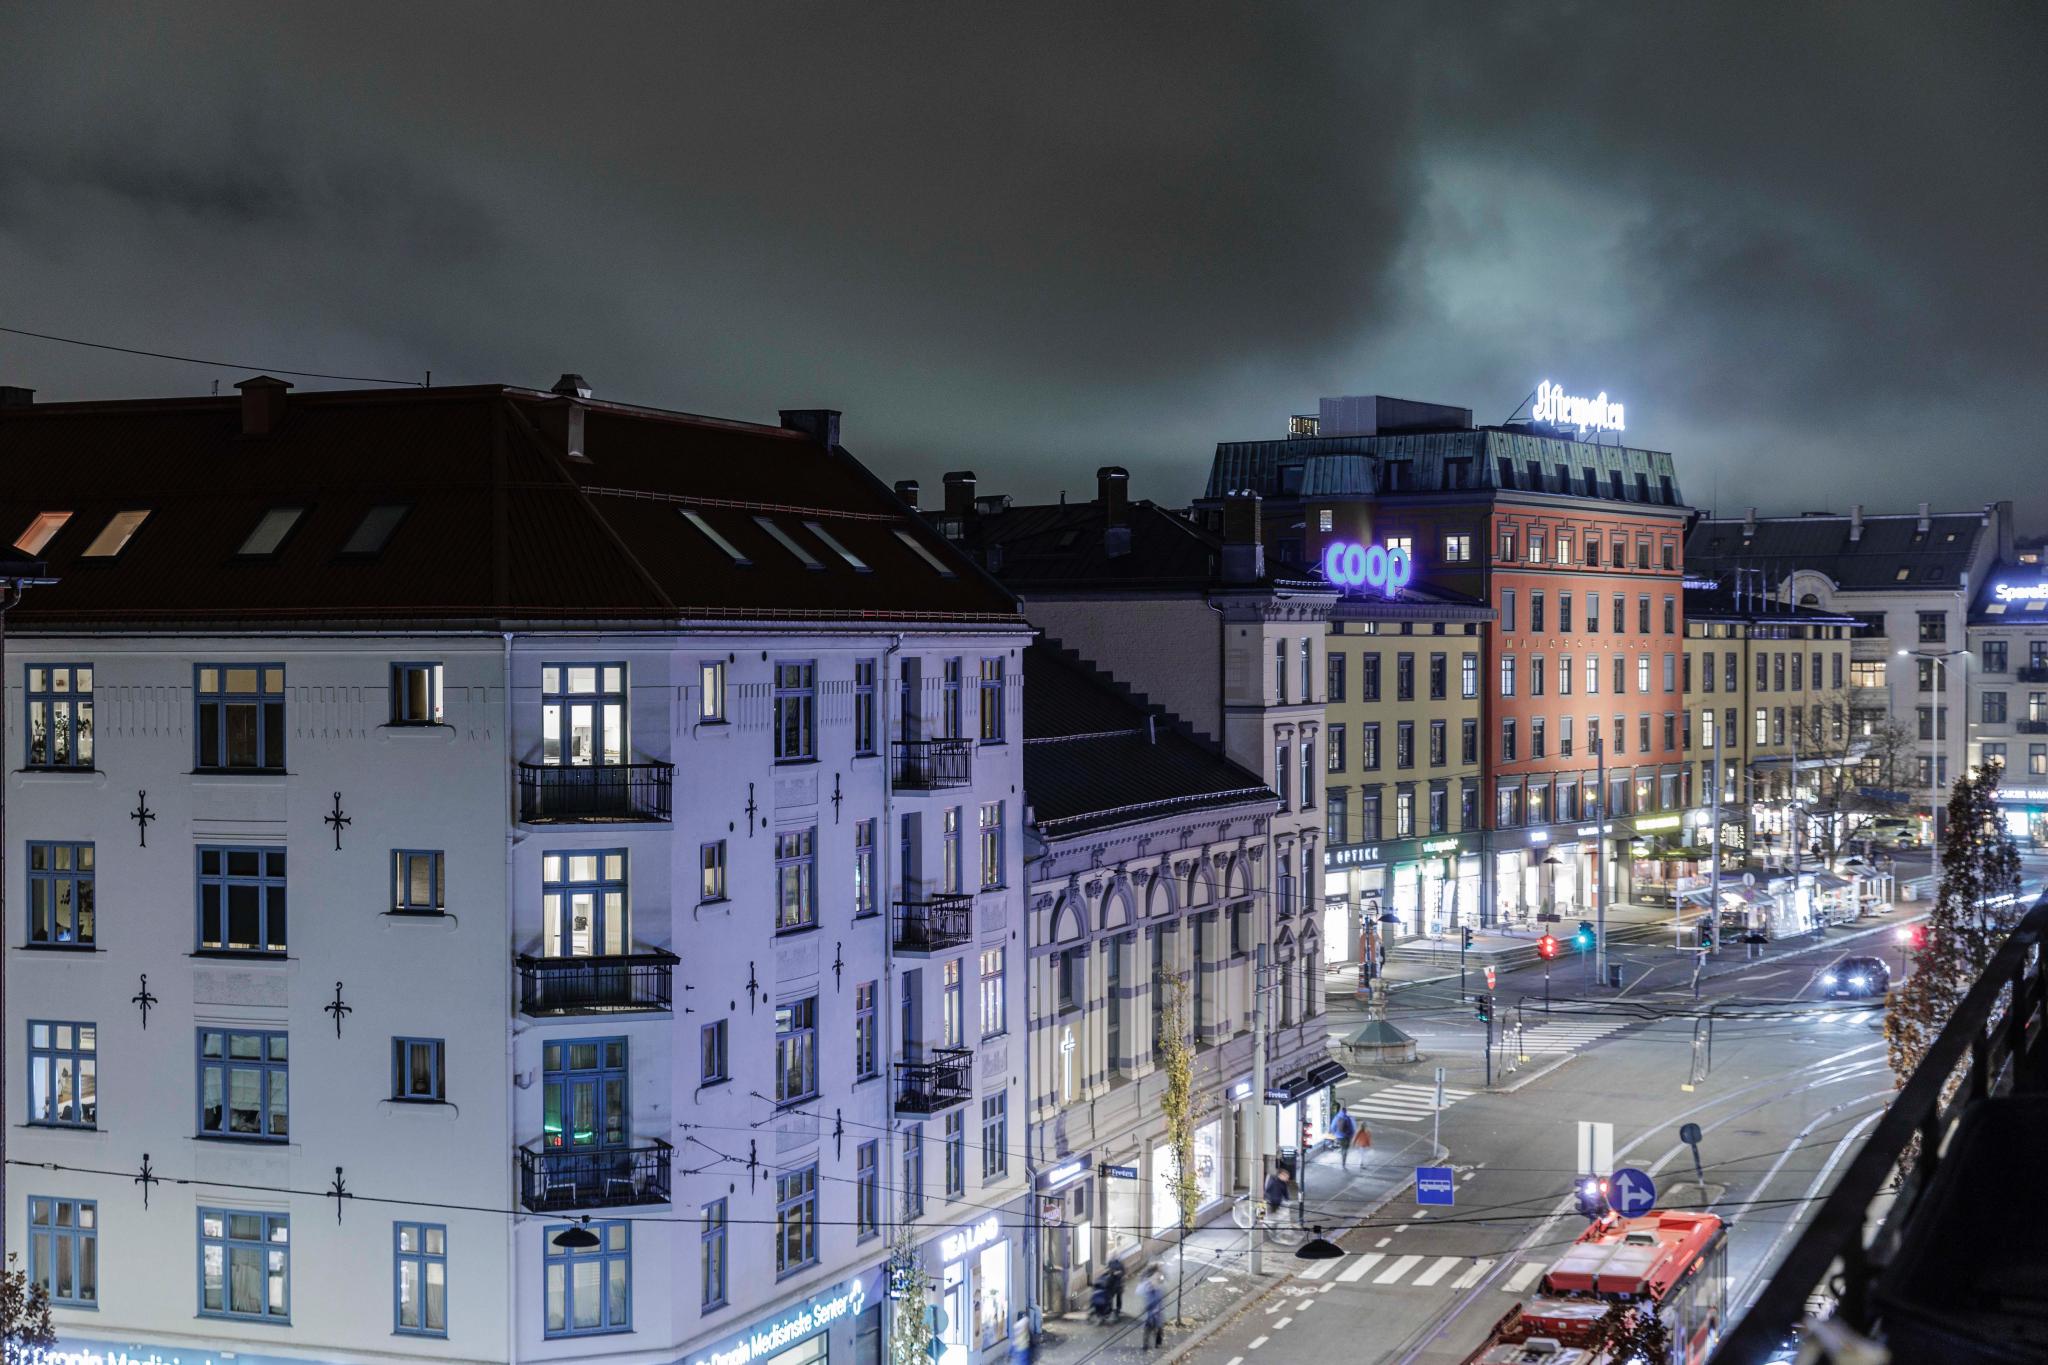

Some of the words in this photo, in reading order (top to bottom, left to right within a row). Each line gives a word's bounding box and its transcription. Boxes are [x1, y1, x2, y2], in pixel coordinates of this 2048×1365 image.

[1533, 379, 1625, 433] Aftenposten
[1327, 542, 1410, 597] coop
[1112, 1168, 1134, 1178] Fretex
[751, 1311, 812, 1359] Medisinske
[813, 1295, 848, 1327] Senter
